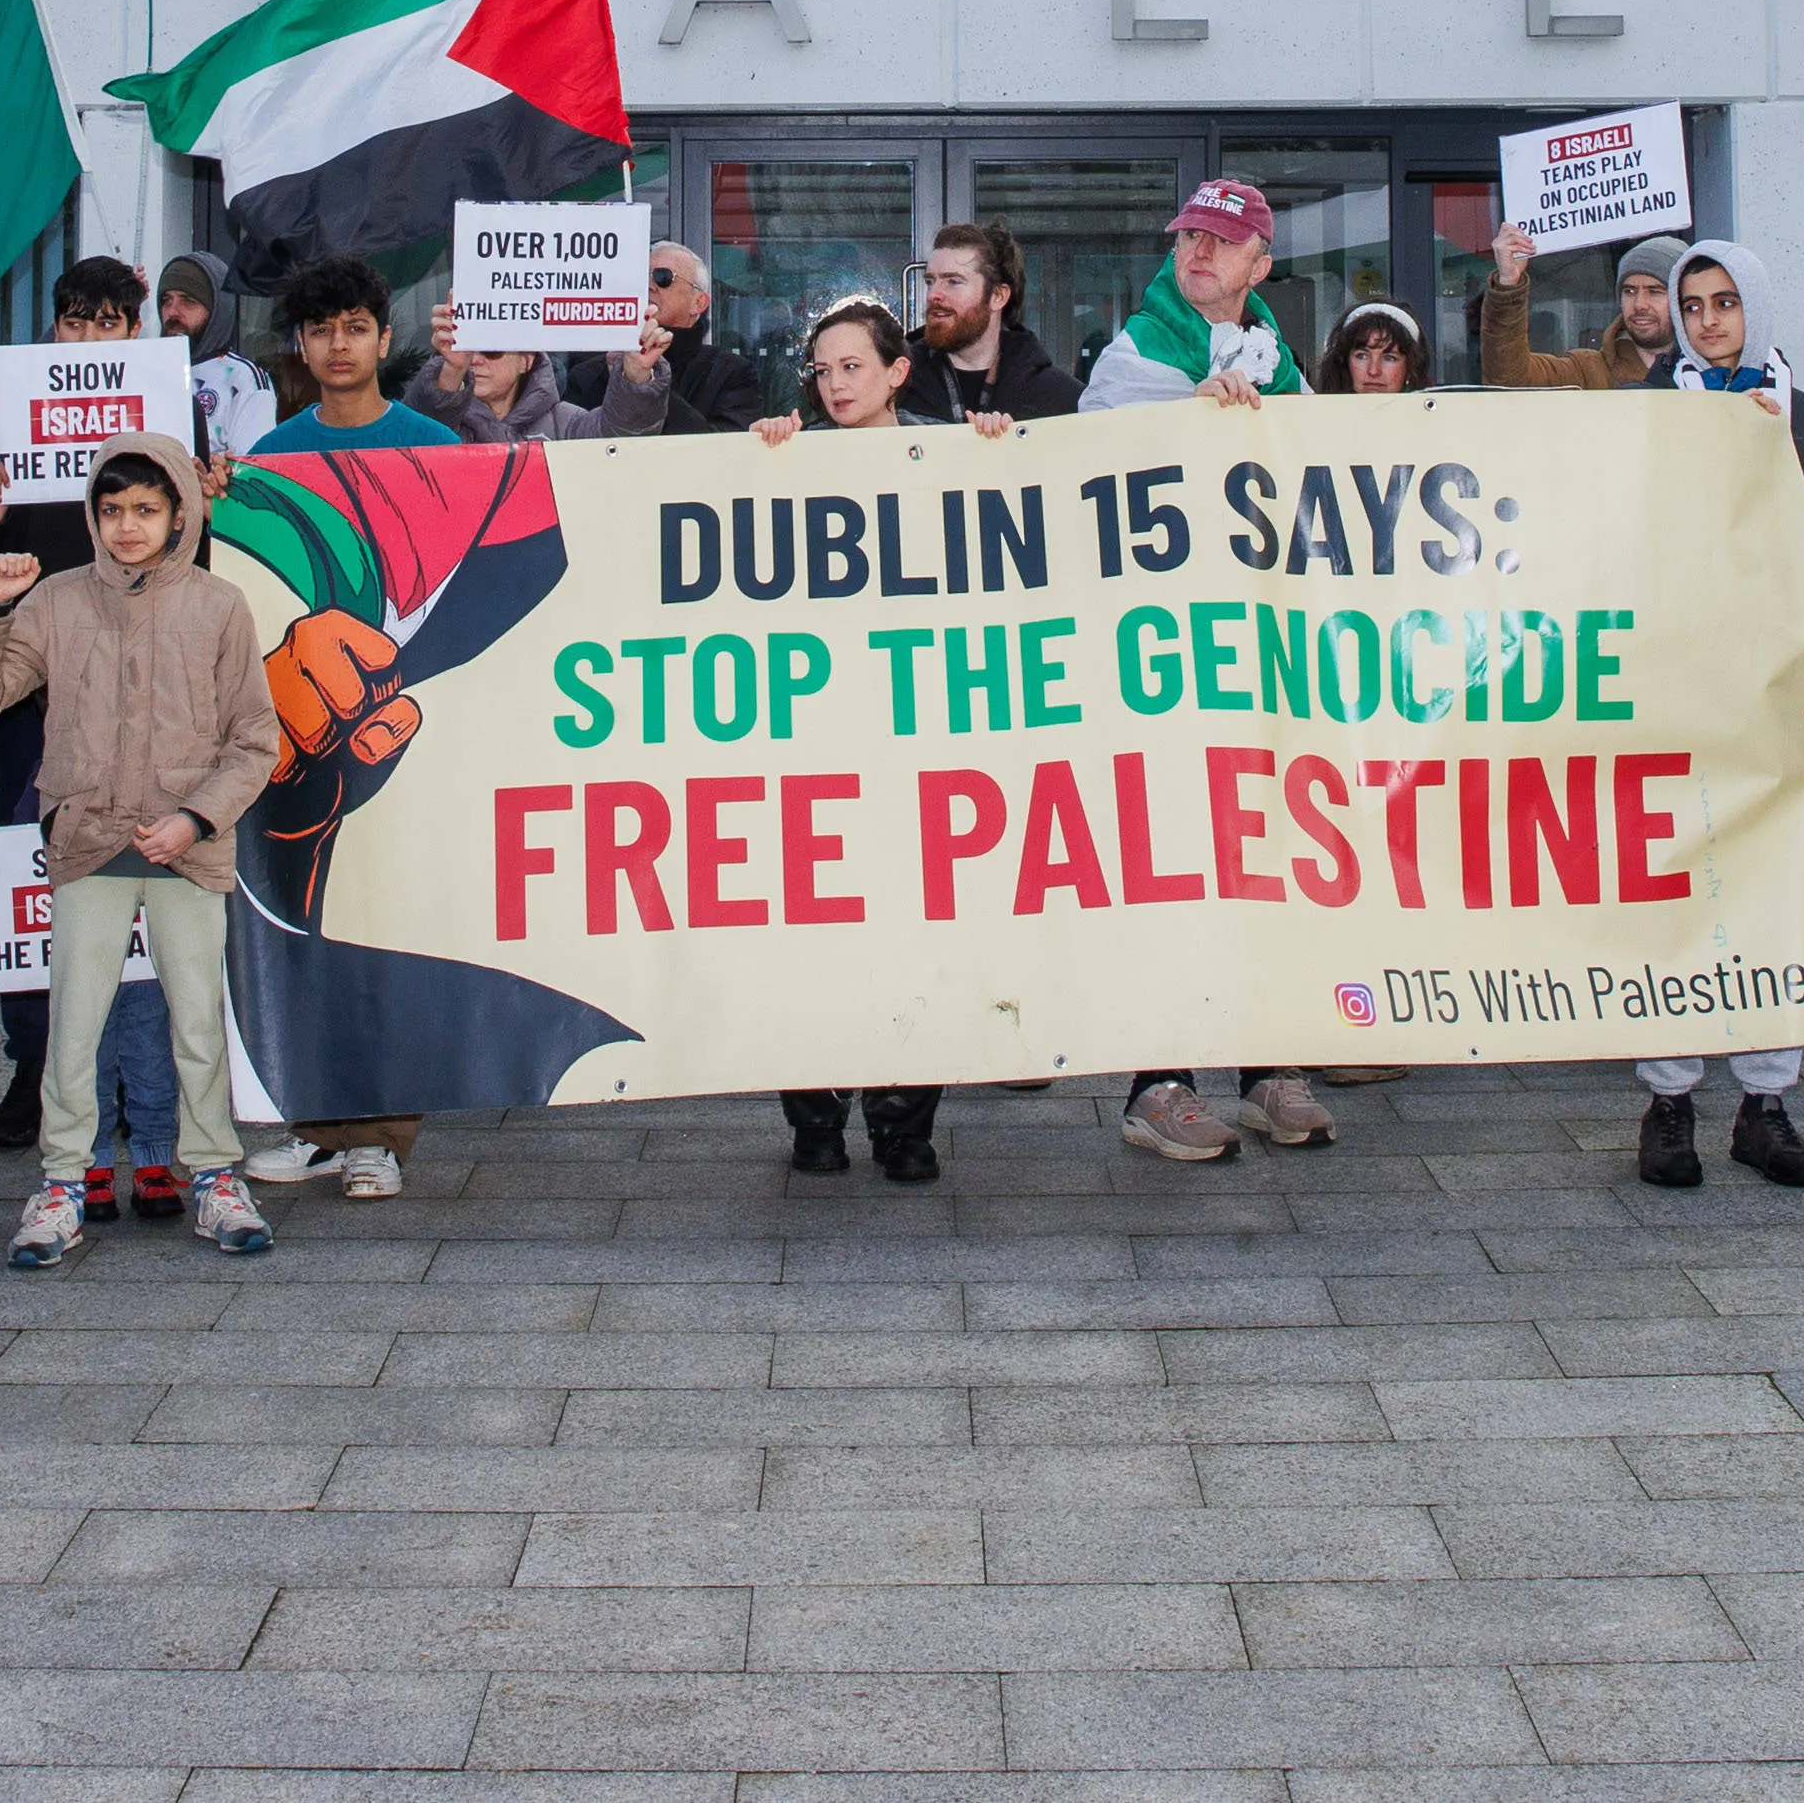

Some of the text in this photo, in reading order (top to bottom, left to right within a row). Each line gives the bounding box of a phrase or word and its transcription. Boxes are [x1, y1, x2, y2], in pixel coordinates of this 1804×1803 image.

[1550, 127, 1630, 159] 8 ISRAELI
[1541, 150, 1642, 186] TEAMS PLAY
[1191, 196, 1245, 216] PALESTINE
[1540, 172, 1648, 210] ON OCCUPIED
[1630, 191, 1677, 215] LAND
[477, 231, 618, 262] OVER 1,000
[491, 271, 602, 290] PALESTINIAN
[454, 301, 637, 322] ATHLETES MURDERED
[49, 361, 125, 392] SHOW
[40, 403, 137, 437] ISRAEL
[660, 461, 1520, 605] DUBLIN 15 SAYS:
[552, 600, 1634, 749] STOP THE GENOCIDE
[494, 772, 866, 942] FREE
[918, 746, 1692, 921] PALESTINE
[1383, 967, 1460, 1024] D15
[1469, 967, 1577, 1024] With
